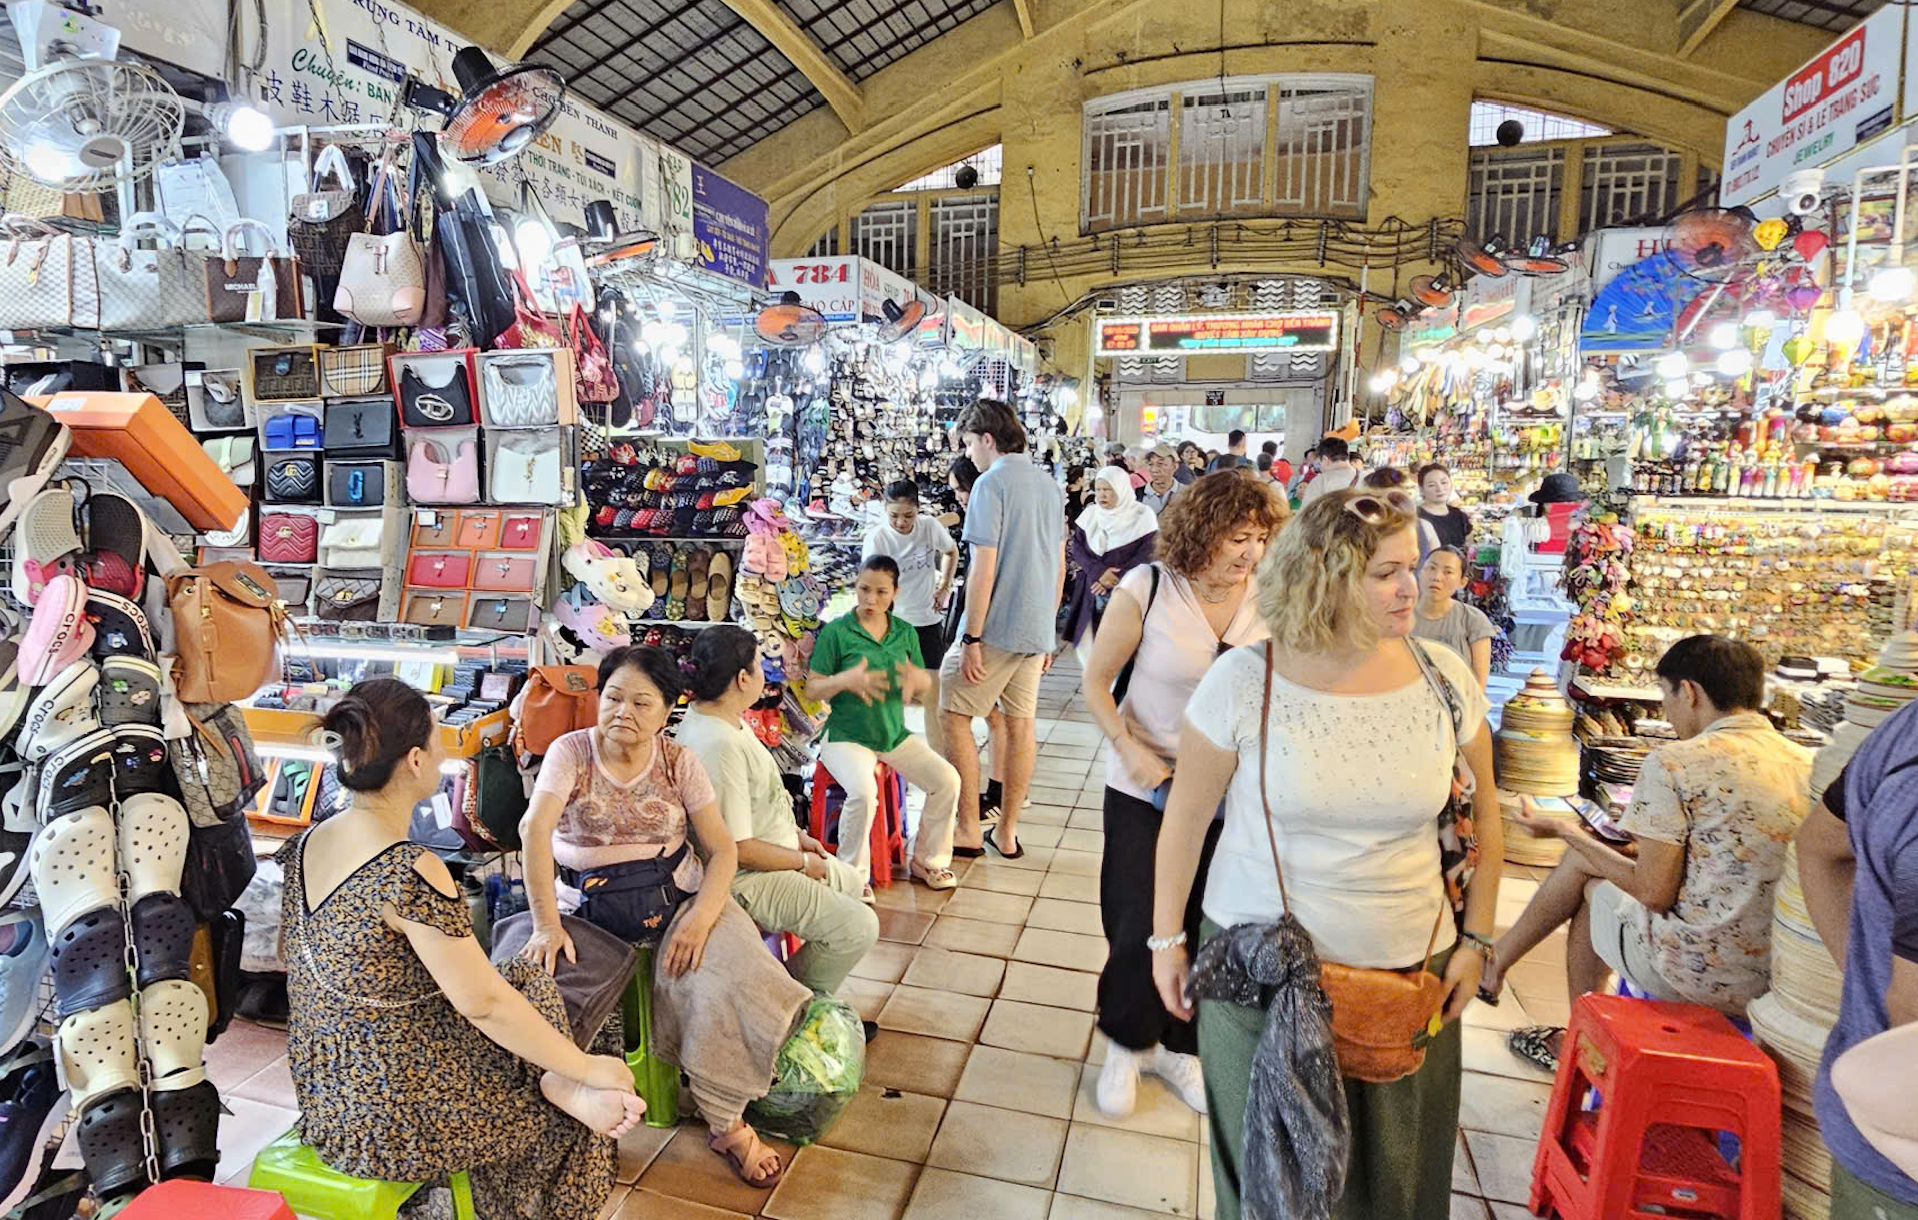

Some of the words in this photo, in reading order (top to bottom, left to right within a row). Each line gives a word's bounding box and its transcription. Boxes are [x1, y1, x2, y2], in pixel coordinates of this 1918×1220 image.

[1784, 71, 1823, 117] Shop
[1828, 39, 1862, 88] 820
[1829, 88, 1858, 121] TRANG
[585, 114, 618, 140] THÀNH
[793, 264, 851, 285] 784
[48, 613, 75, 654] crocs
[30, 700, 54, 734] crocs
